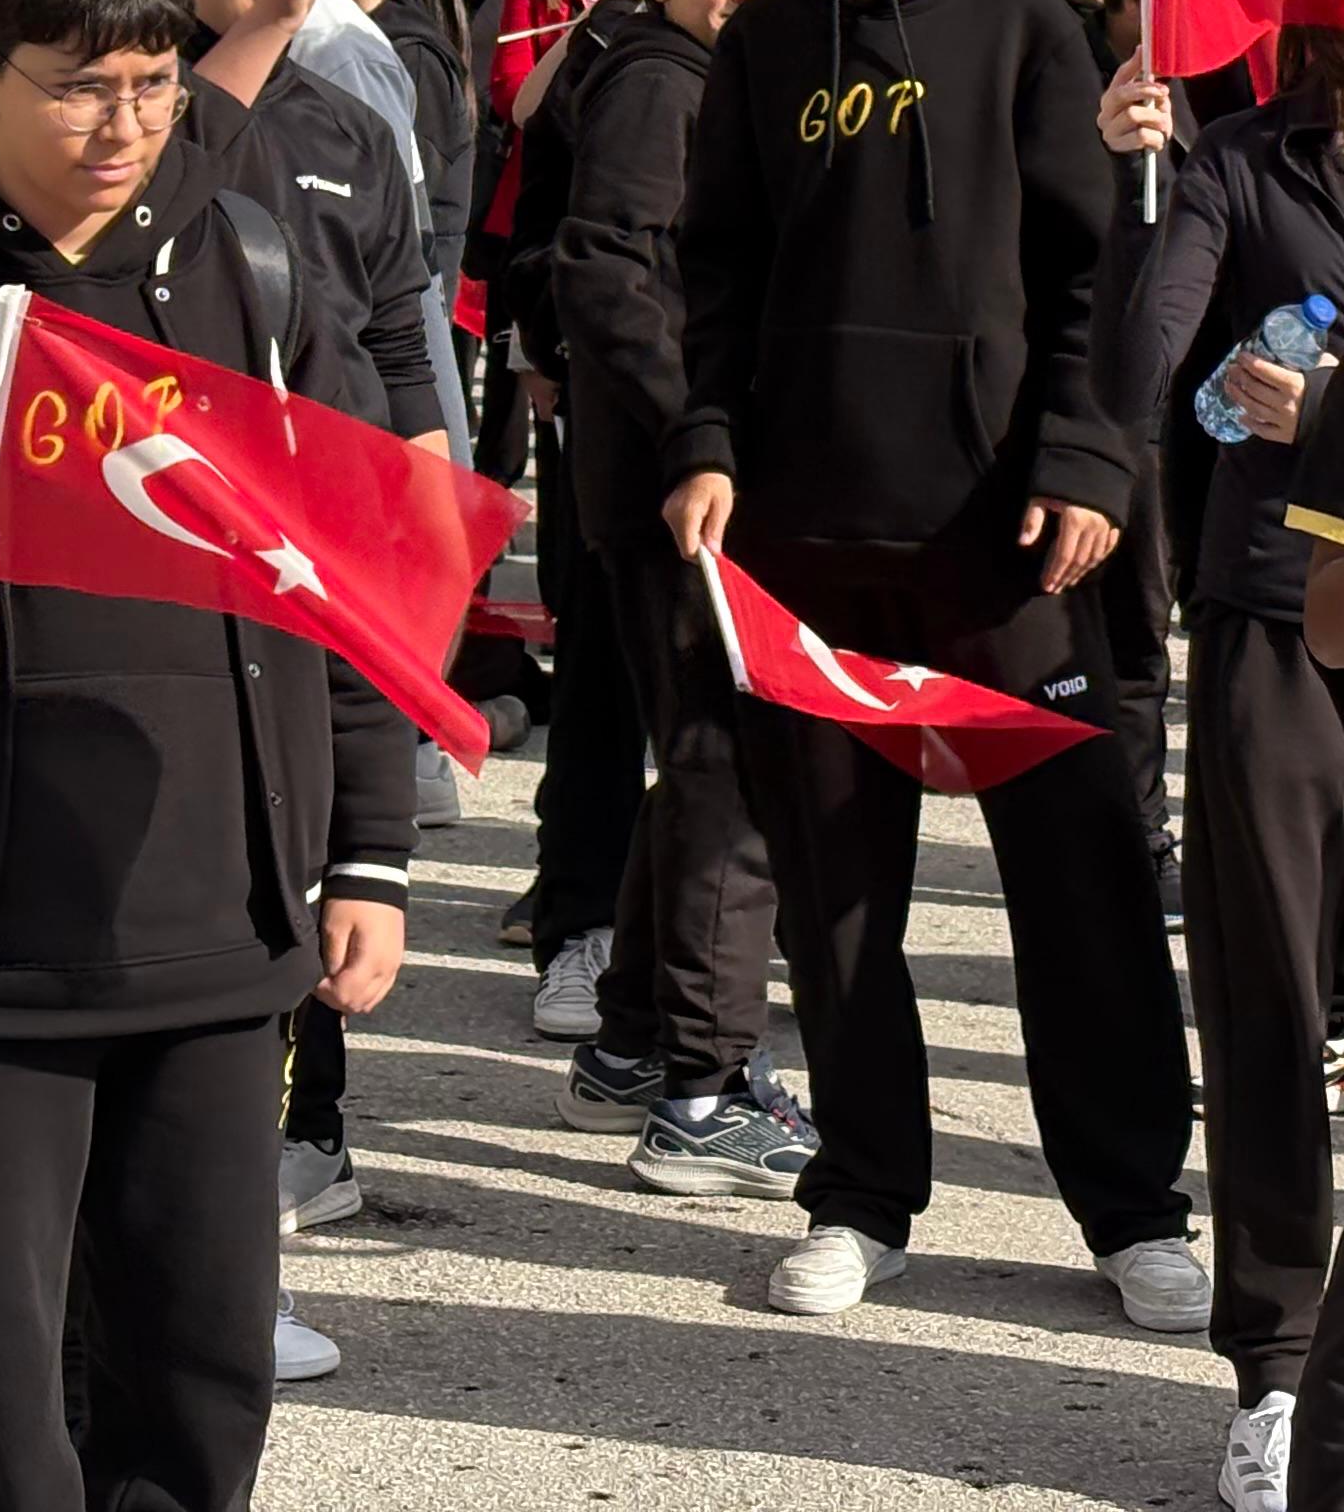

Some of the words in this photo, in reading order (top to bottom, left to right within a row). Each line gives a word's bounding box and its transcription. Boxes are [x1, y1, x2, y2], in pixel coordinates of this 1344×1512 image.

[800, 80, 925, 143] GOP
[23, 376, 183, 465] GOP
[1043, 675, 1088, 701] VOID
